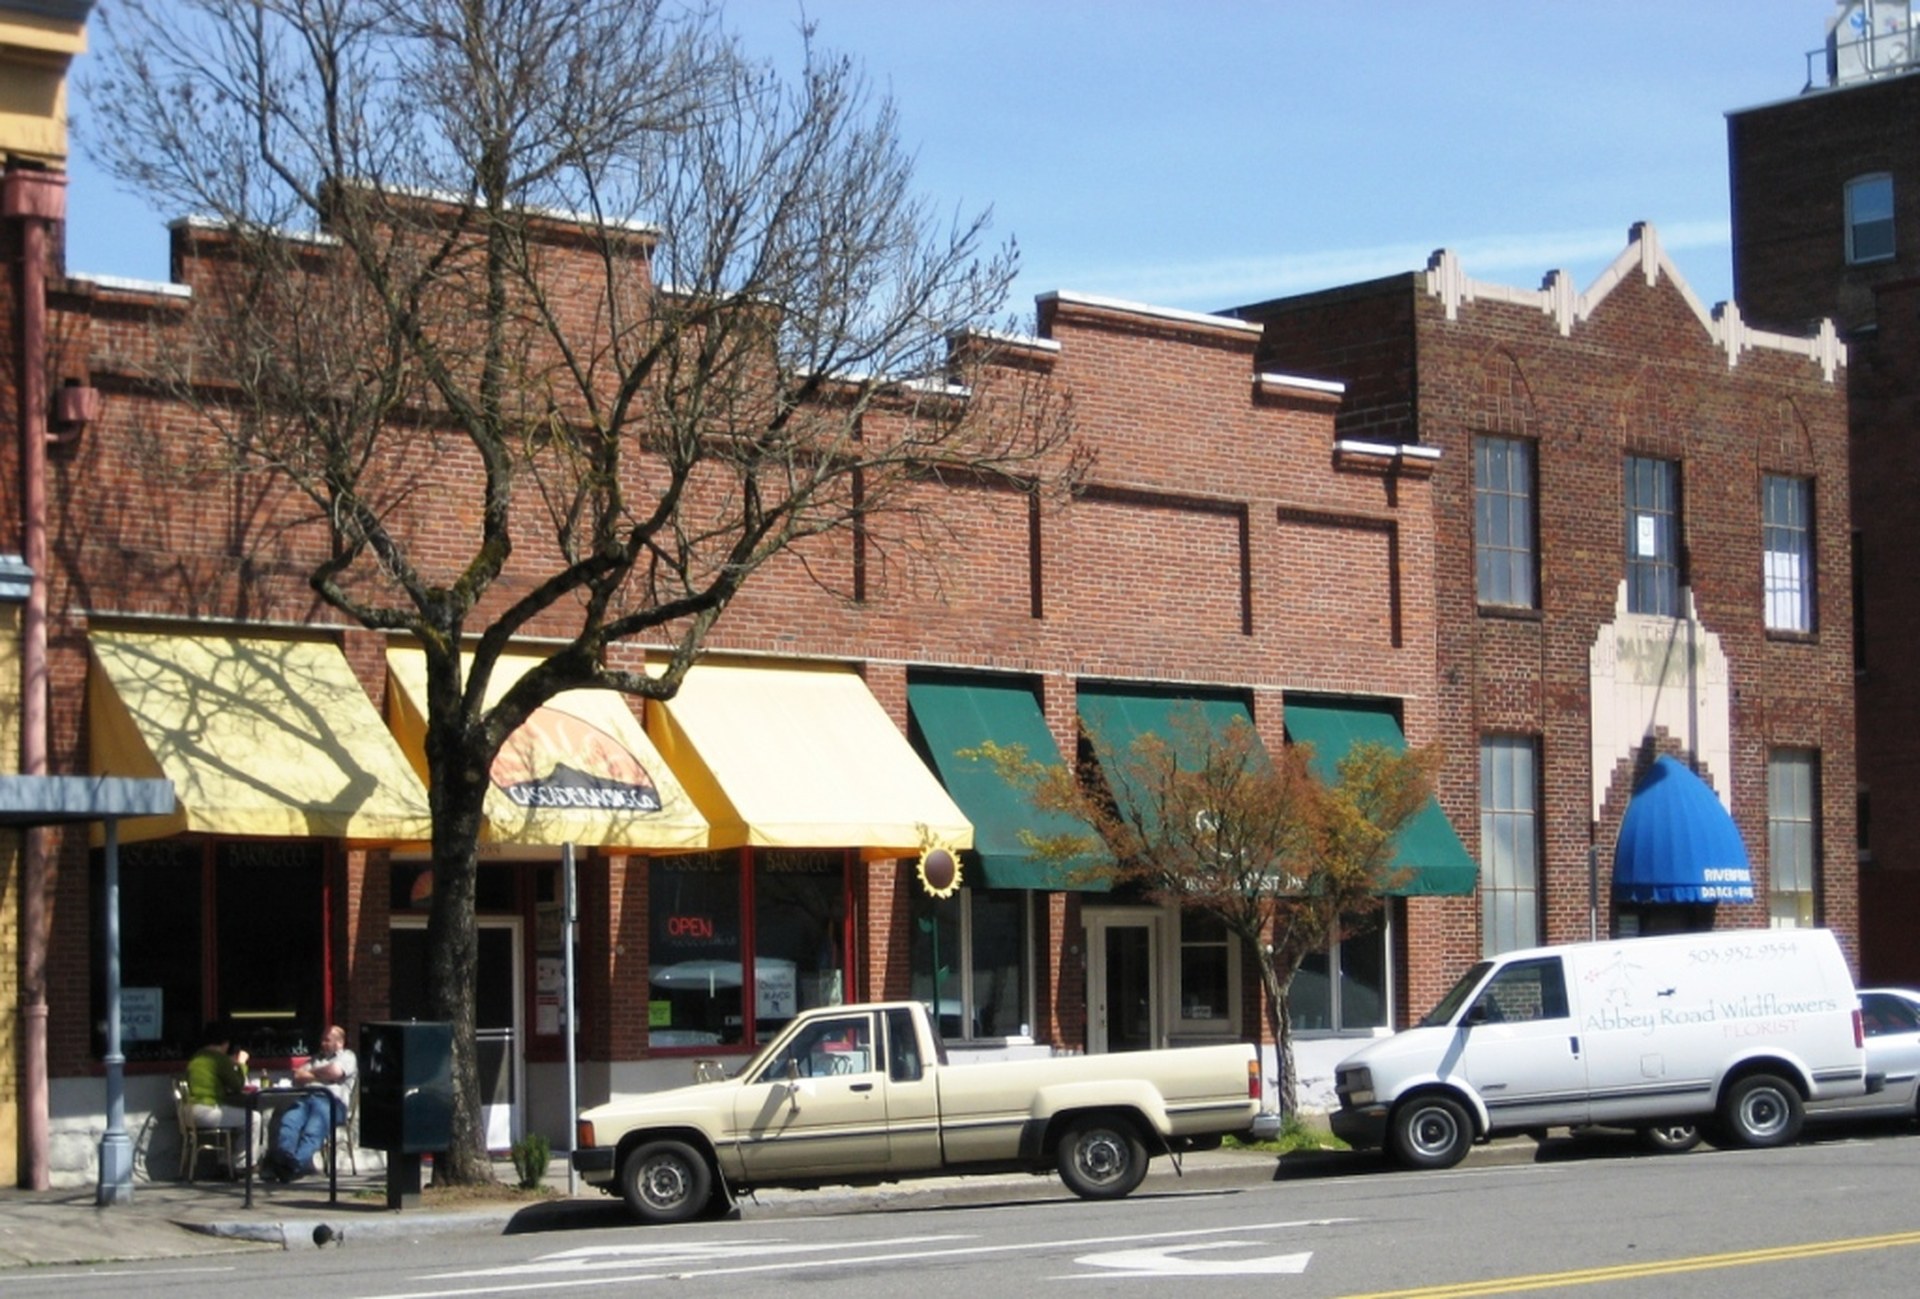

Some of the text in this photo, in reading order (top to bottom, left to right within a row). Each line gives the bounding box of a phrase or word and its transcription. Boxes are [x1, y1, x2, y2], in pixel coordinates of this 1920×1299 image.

[509, 785, 582, 807] CASCADE
[667, 916, 713, 938] OPEN
[1585, 992, 1838, 1036] Abbey Road Wildflowers
[1722, 1018, 1799, 1039] FLORIST
